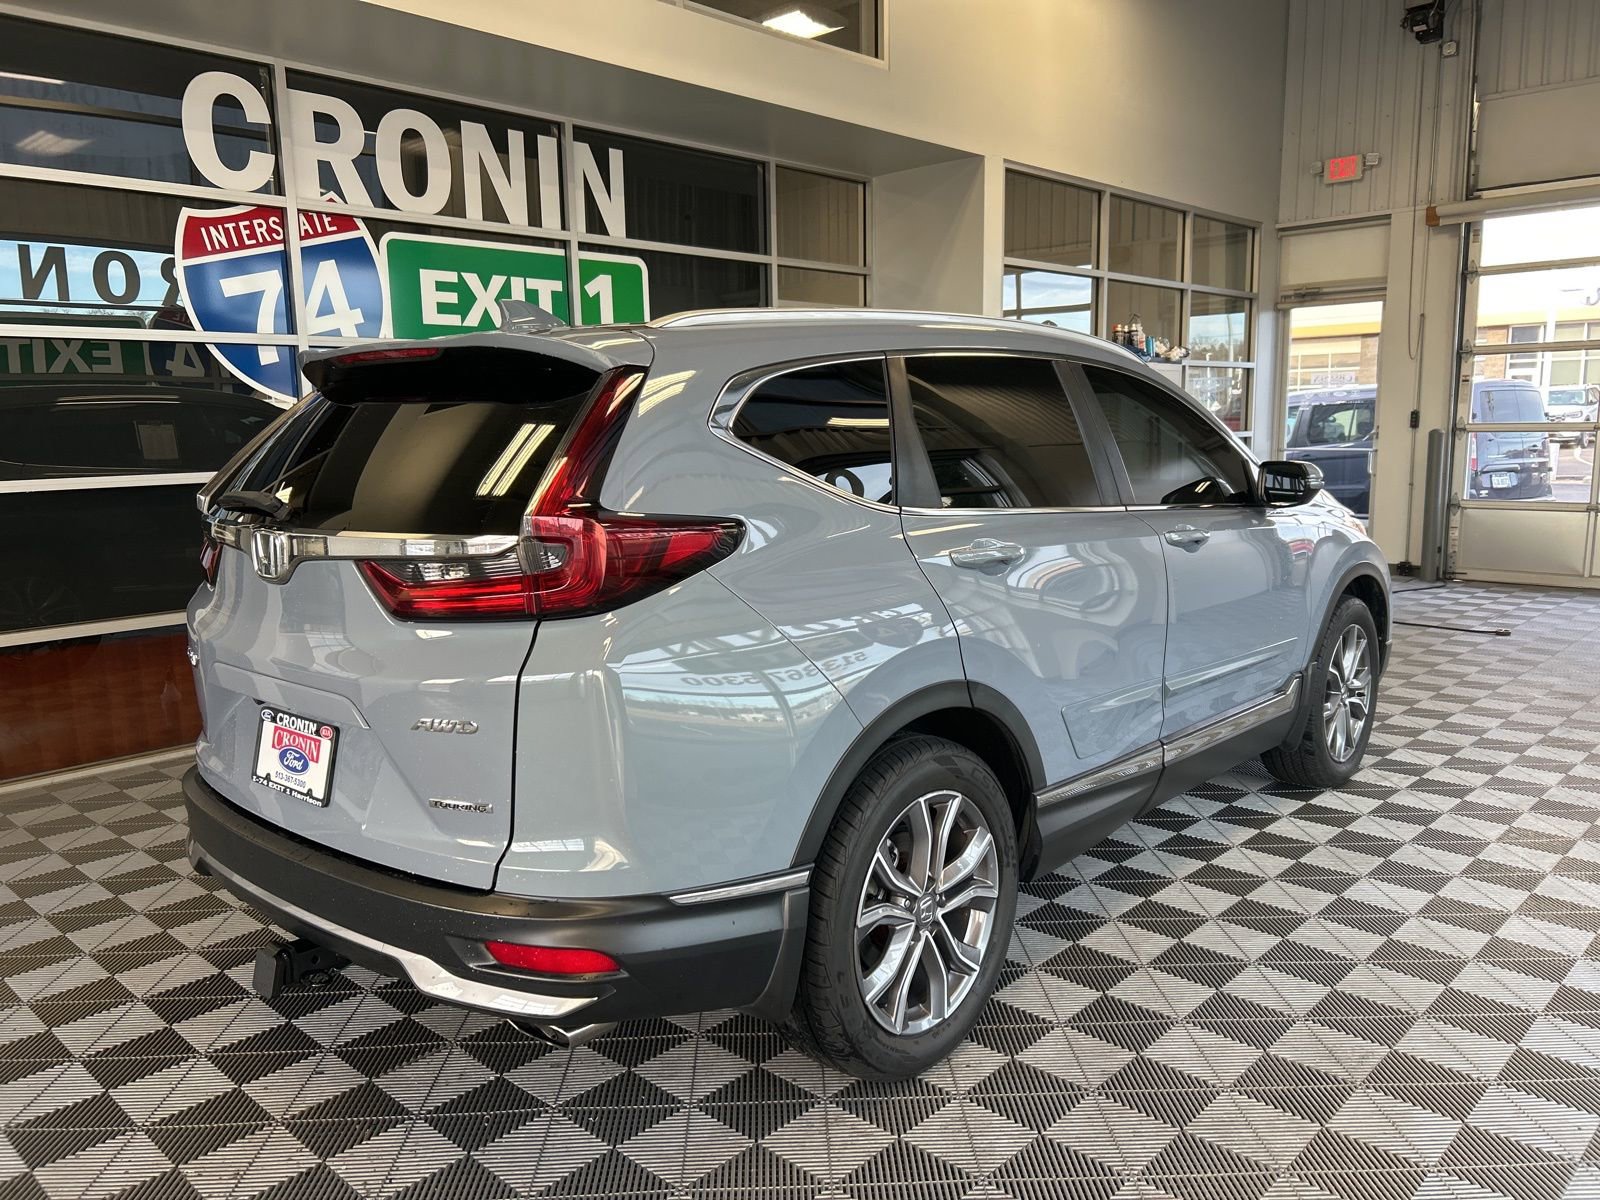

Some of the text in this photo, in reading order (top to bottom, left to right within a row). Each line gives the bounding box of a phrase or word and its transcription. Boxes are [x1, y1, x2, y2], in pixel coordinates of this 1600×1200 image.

[182, 71, 626, 238] CRONIN
[200, 212, 338, 252] INTERSATE
[219, 259, 365, 365] 74
[419, 268, 614, 328] EXIT 1
[276, 712, 317, 736] CRONIN
[411, 718, 479, 735] AWD
[274, 729, 319, 762] CRONIN
[283, 750, 305, 771] Ford
[252, 775, 268, 786] I-74
[268, 781, 285, 793] EXIT
[291, 789, 322, 807] Harrison
[431, 799, 487, 813] TOURING
